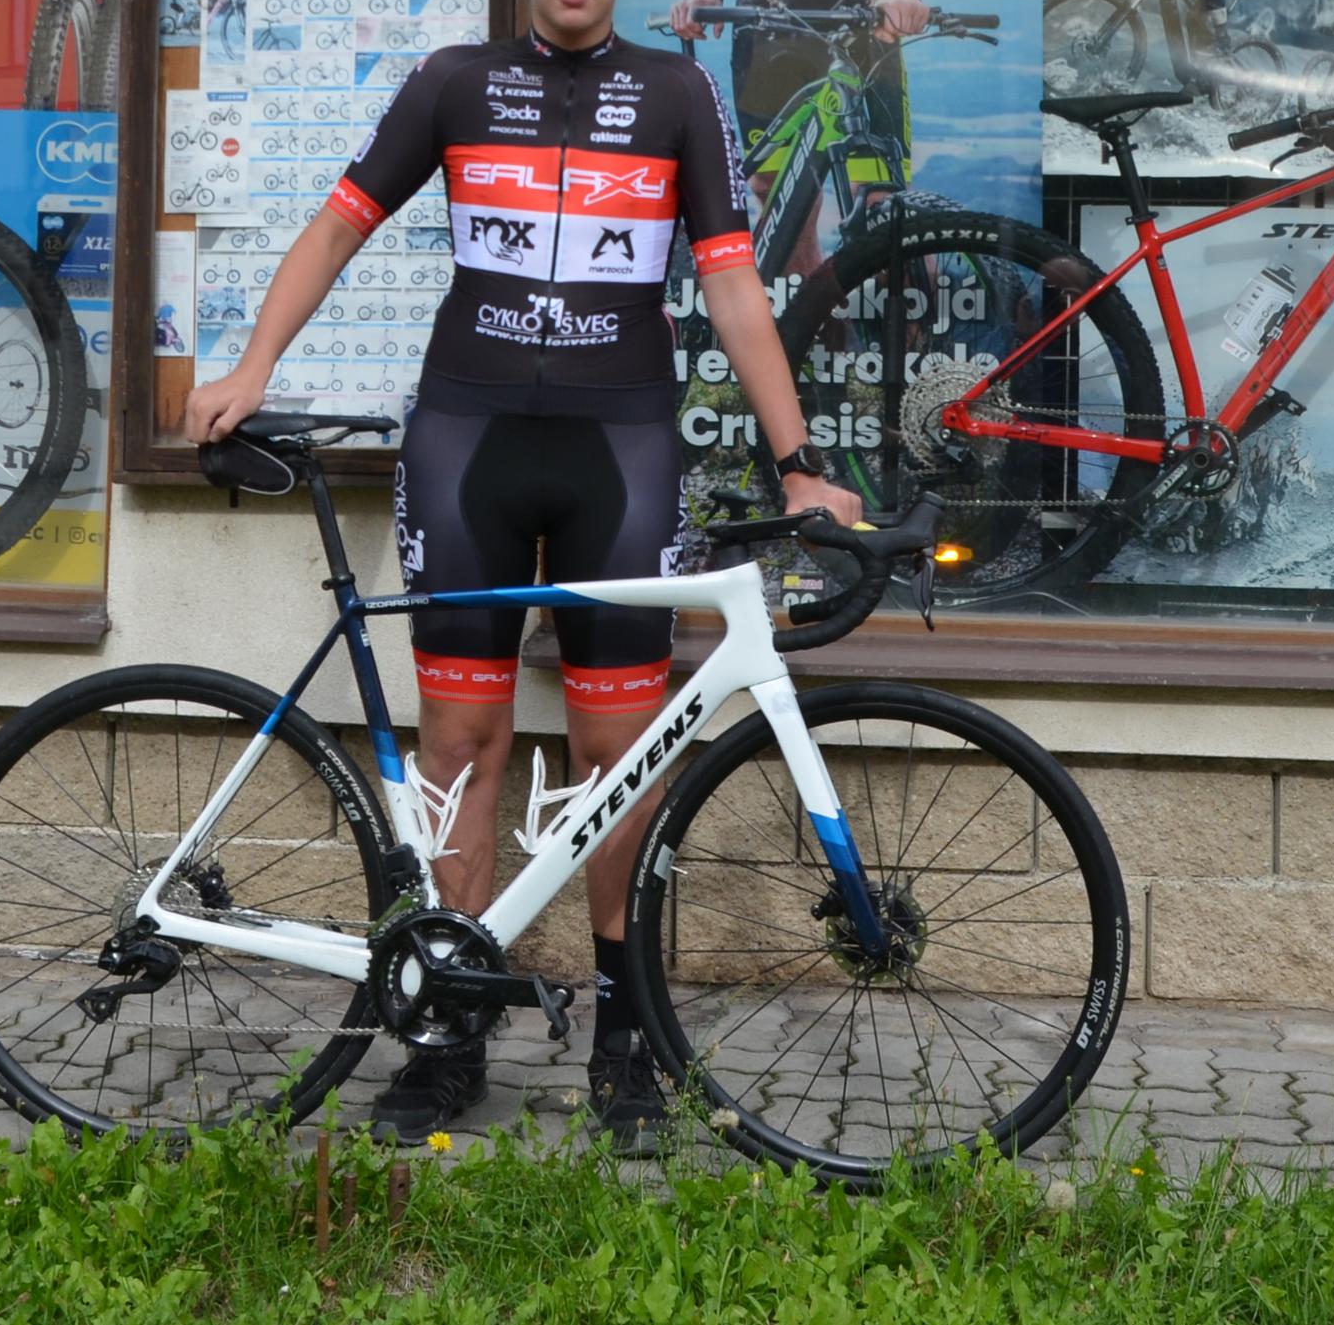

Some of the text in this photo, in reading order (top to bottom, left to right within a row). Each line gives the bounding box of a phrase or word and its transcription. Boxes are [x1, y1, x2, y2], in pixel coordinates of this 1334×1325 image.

[487, 101, 541, 122] Deda
[504, 88, 544, 98] KENDA
[599, 112, 633, 122] KMC
[462, 163, 666, 207] GALAXY
[469, 215, 536, 256] FOX
[901, 229, 1000, 247] MAXXIS
[588, 266, 634, 275] marzocchi
[478, 303, 619, 336] CYKLO ŠVEC
[932, 274, 987, 334] já
[394, 460, 409, 548] CYKLO
[365, 598, 410, 609] IZOARD
[316, 761, 362, 822] DT SWISS
[323, 747, 382, 843] CONTINENTAL
[570, 691, 704, 861] STEVENS
[1101, 928, 1124, 1045] CONTINENTAL
[1075, 977, 1107, 1050] DT SWISS
